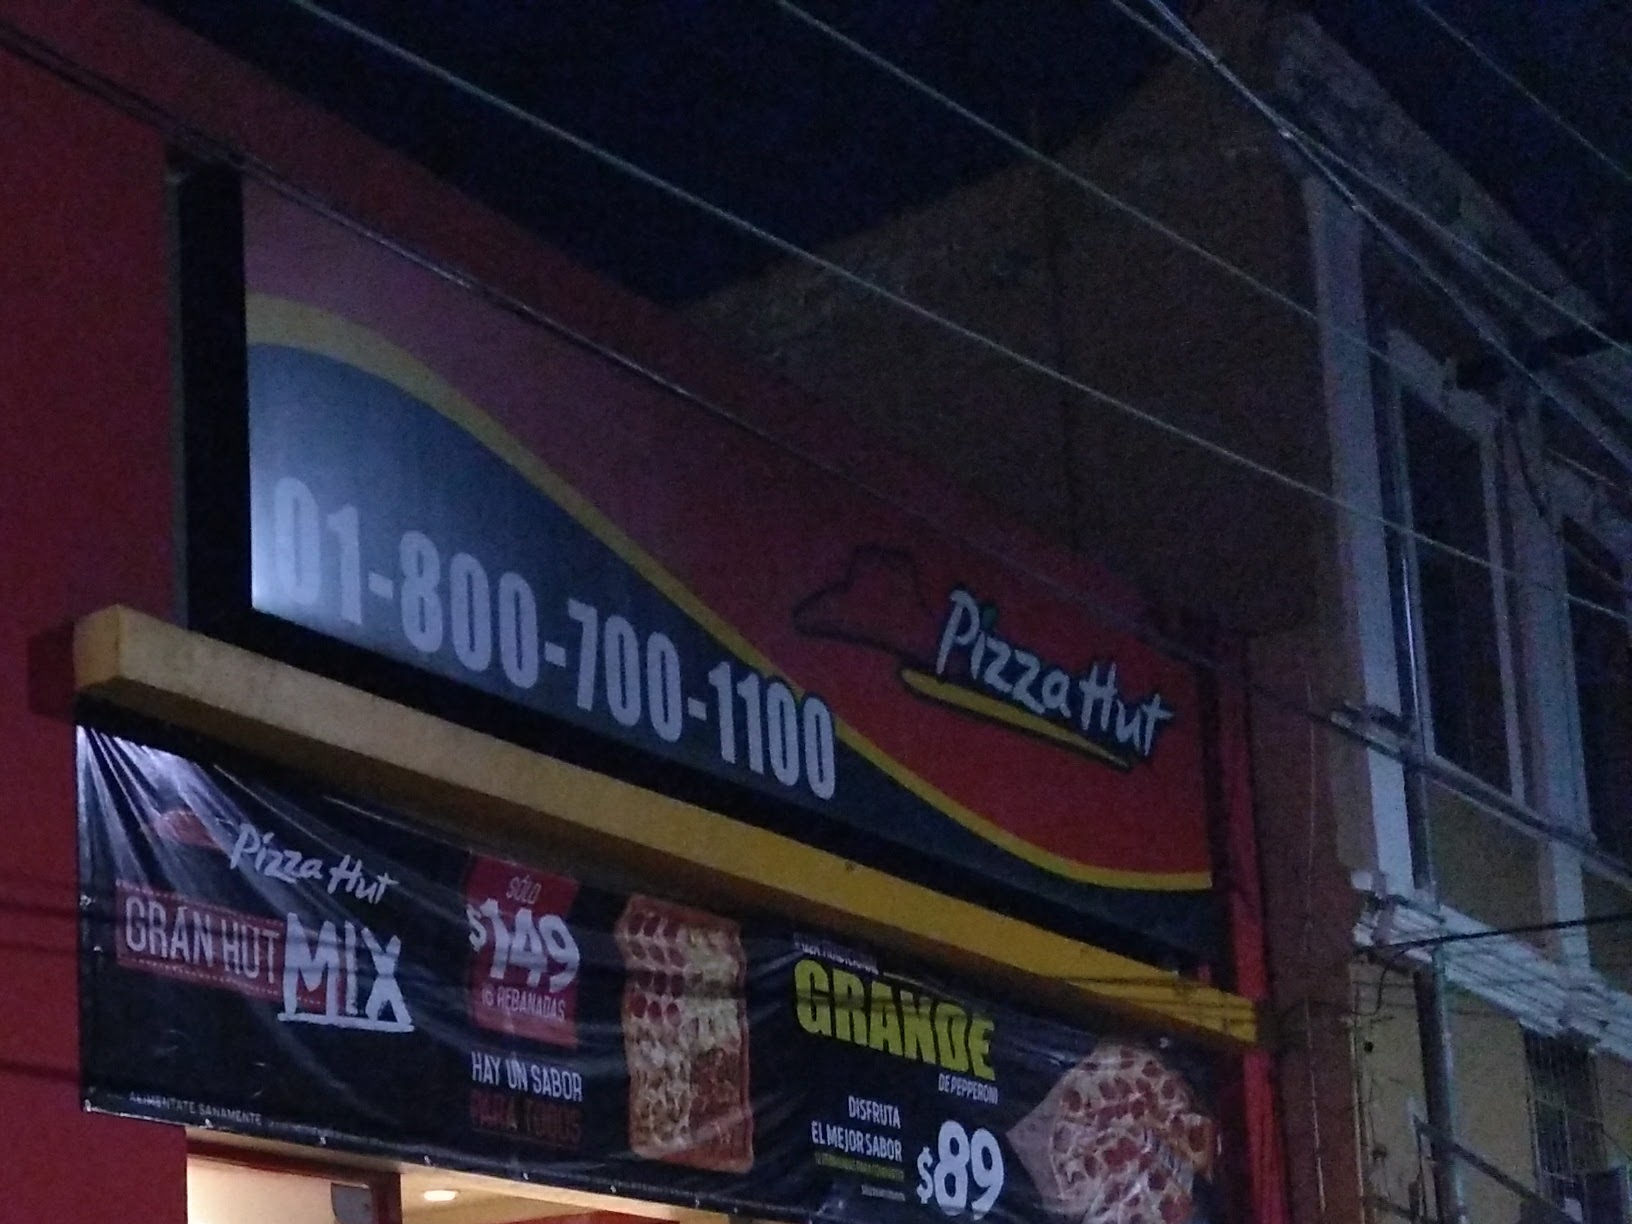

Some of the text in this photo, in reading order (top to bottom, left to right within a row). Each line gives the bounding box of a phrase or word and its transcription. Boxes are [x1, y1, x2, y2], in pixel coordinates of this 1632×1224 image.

[274, 477, 836, 801] 01-800-700-1100
[935, 588, 1173, 756] Pizza Hut
[228, 822, 400, 905] Pizza Hut
[124, 896, 282, 985] GRAN HUT
[282, 912, 414, 1026] MIX
[466, 897, 581, 994] $149
[793, 958, 997, 1082] GRANDE
[471, 1050, 584, 1102] HAY UN SABOR
[847, 1094, 902, 1130] DISFRUTA
[811, 1120, 903, 1163] EL MEJOR SABOR
[916, 1118, 1005, 1220] $89
